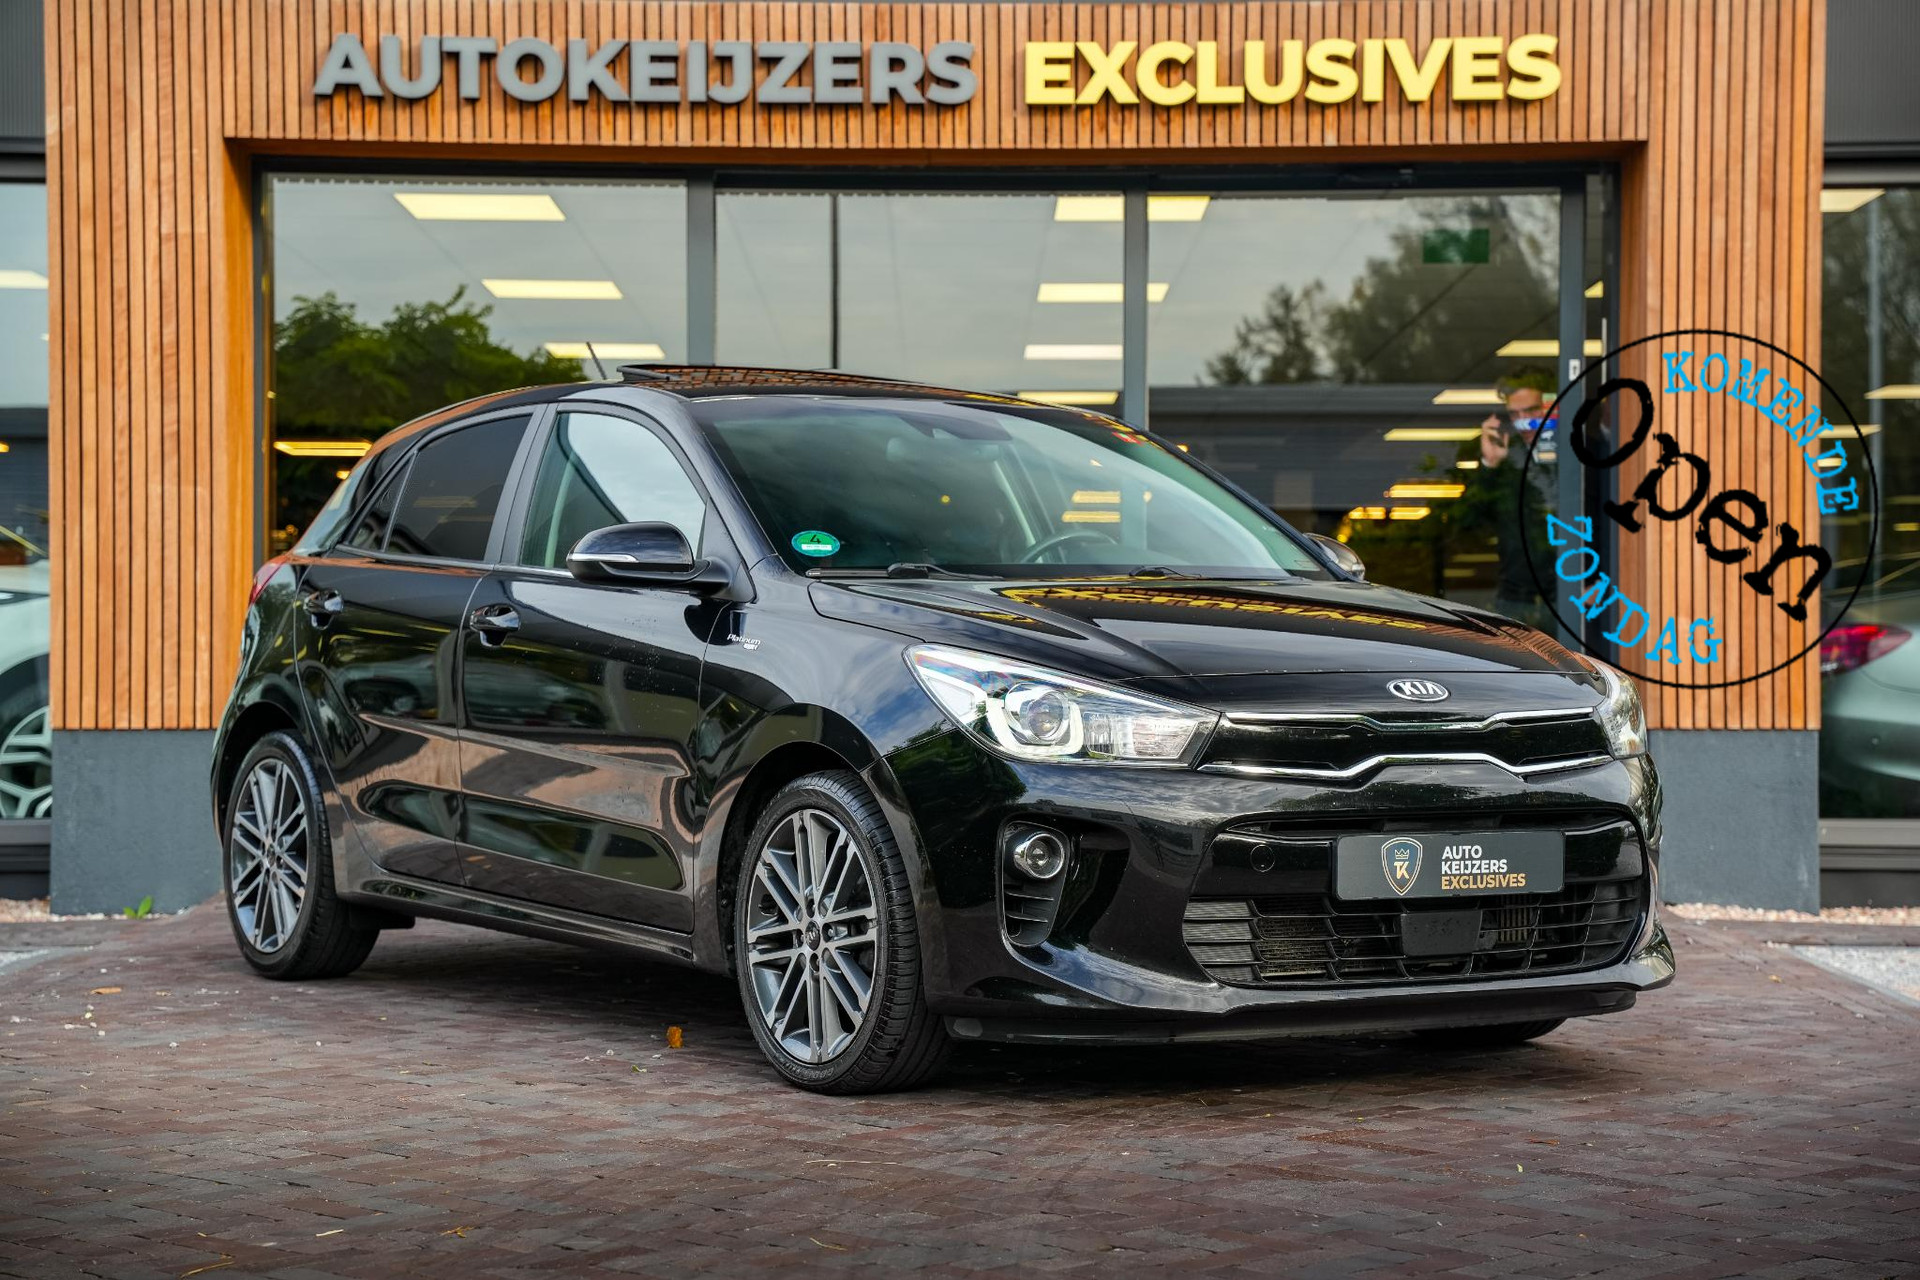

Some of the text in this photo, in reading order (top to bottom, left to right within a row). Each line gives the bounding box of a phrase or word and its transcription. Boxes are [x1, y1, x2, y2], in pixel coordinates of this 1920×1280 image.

[313, 32, 1563, 108] AUTOKEIJZERS EXCLUSIVES
[809, 534, 822, 544] 4
[1396, 681, 1444, 696] KIA
[1441, 844, 1483, 860] AUTO
[1441, 858, 1508, 875] KEIJZERS
[1441, 873, 1526, 890] EXCLUSIVES
